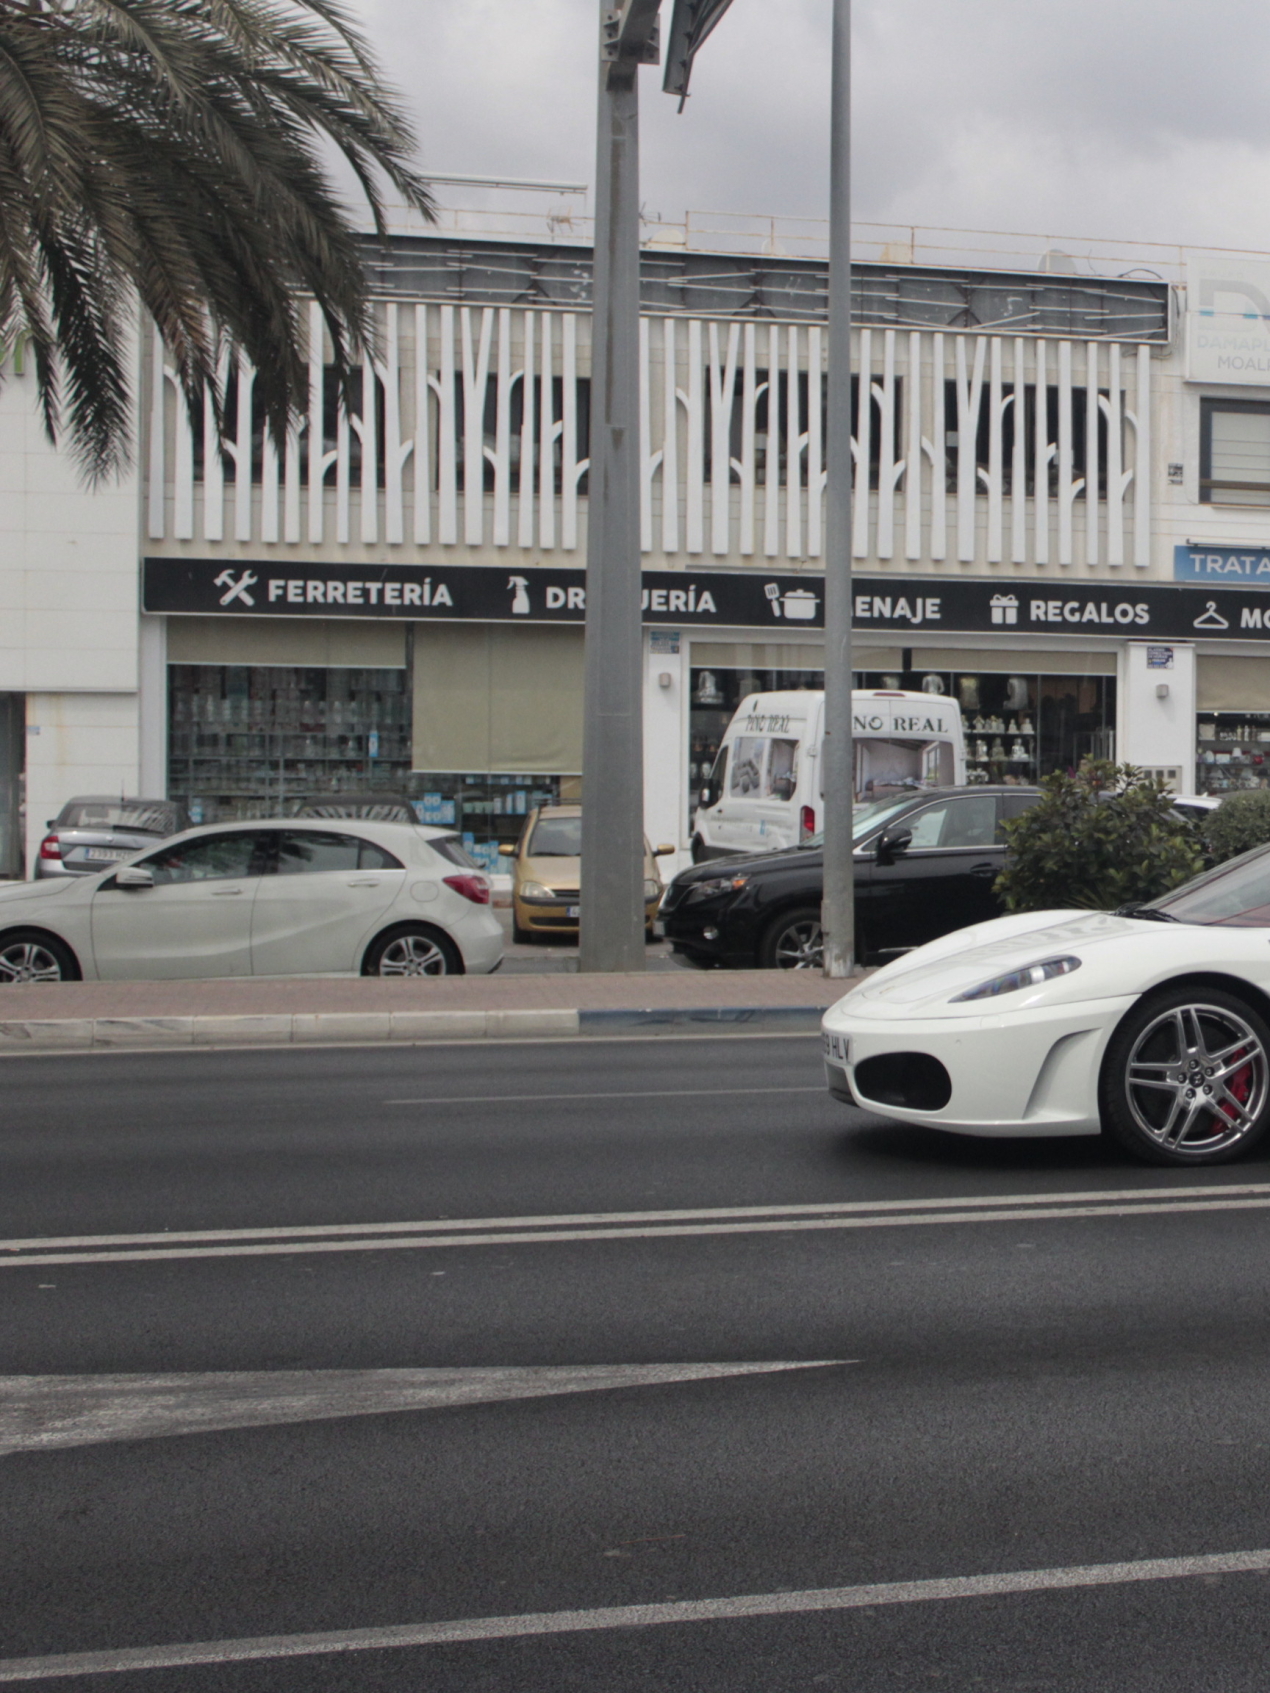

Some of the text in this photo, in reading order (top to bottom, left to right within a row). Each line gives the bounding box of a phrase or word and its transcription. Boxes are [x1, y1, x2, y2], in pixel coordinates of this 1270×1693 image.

[267, 577, 453, 608] FERRETERÍA
[546, 584, 717, 615] DRERÍA
[852, 595, 941, 625] ENAJE
[1030, 600, 1150, 626] REGALOS
[853, 715, 949, 734] NO REAL
